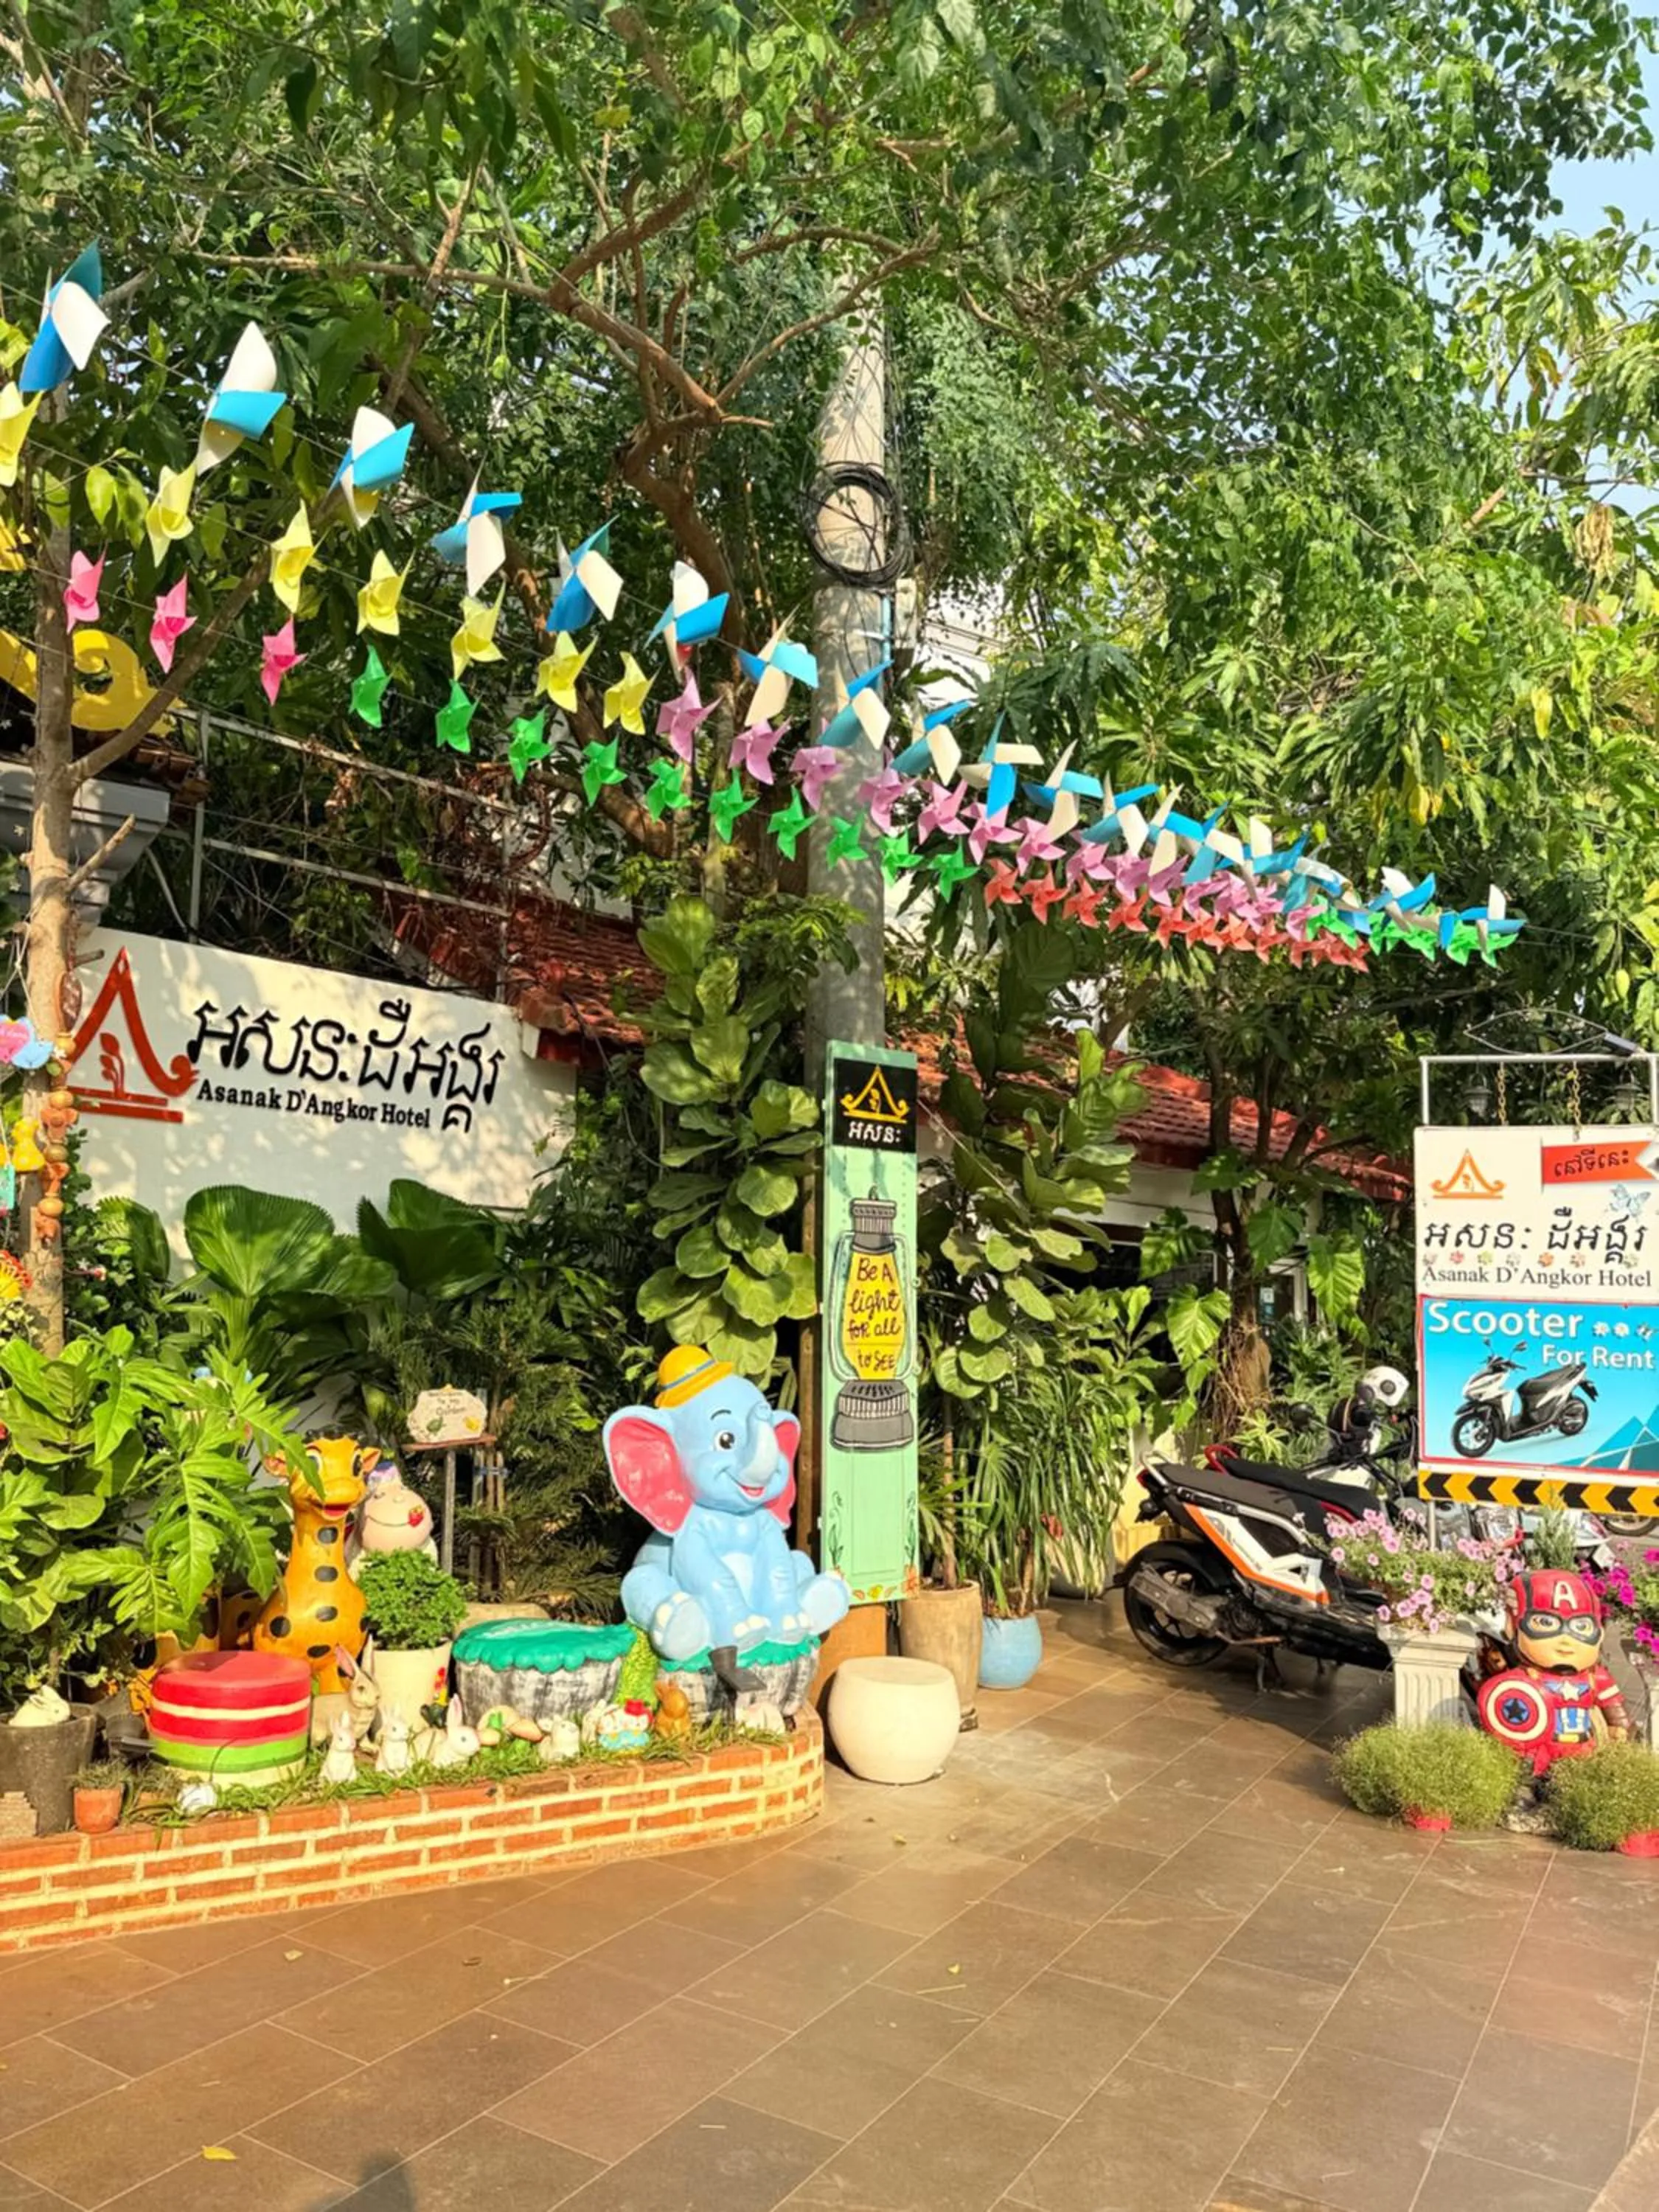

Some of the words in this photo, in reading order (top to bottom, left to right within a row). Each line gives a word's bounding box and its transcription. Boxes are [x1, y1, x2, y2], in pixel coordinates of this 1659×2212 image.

[196, 1079, 282, 1110] Asanak
[381, 1102, 431, 1129] Hotel
[856, 1257, 878, 1281] Be
[881, 1262, 894, 1283] A
[1422, 1266, 1489, 1283] Asanak
[1598, 1270, 1652, 1287] Hotel
[874, 1316, 901, 1337] all
[1427, 1301, 1584, 1338] Scooter
[1542, 1344, 1585, 1366] For
[1591, 1346, 1655, 1370] Rent
[1553, 1580, 1578, 1610] A
